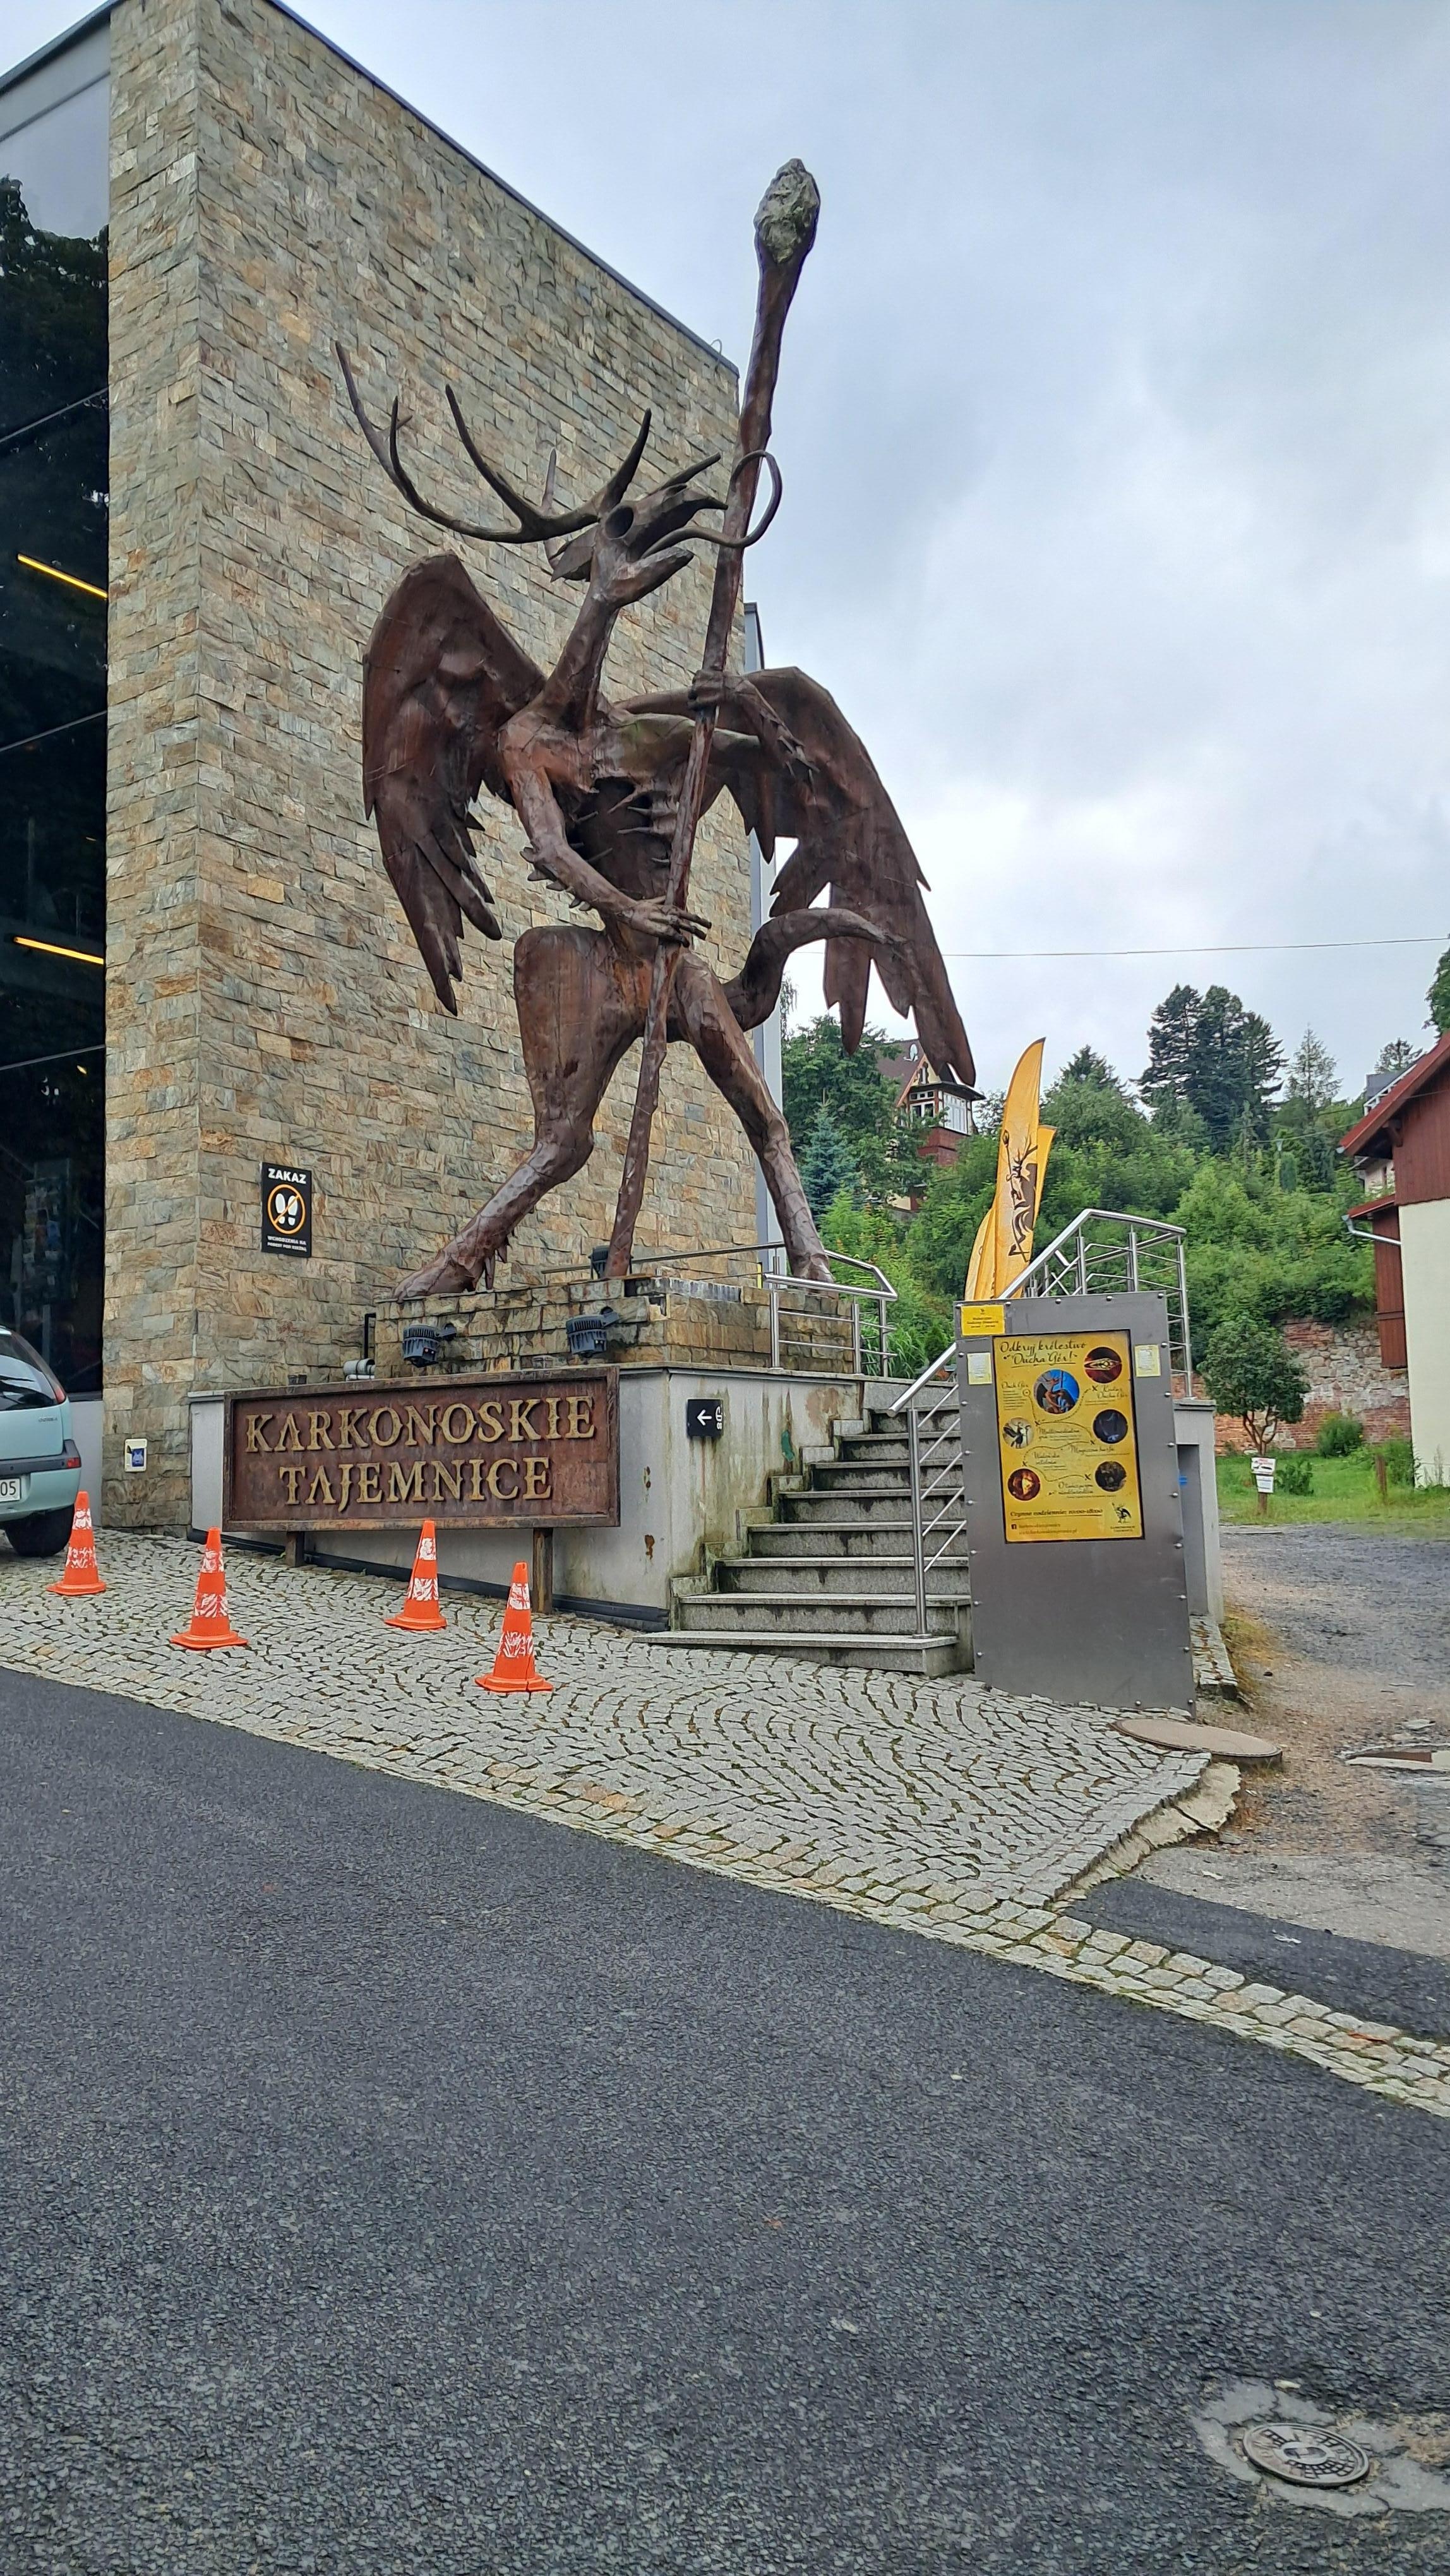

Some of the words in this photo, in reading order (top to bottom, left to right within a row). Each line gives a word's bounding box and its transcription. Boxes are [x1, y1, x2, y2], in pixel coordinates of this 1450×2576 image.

[268, 1168, 306, 1184] ZAKAZ
[1000, 1341, 1036, 1357] Odkryj
[1038, 1339, 1087, 1351] królestwo
[1012, 1352, 1045, 1365] Ducha
[245, 1396, 596, 1453] KARKONOSKIE
[1, 1481, 16, 1496] 05
[279, 1457, 551, 1513] TAJEMNICE
